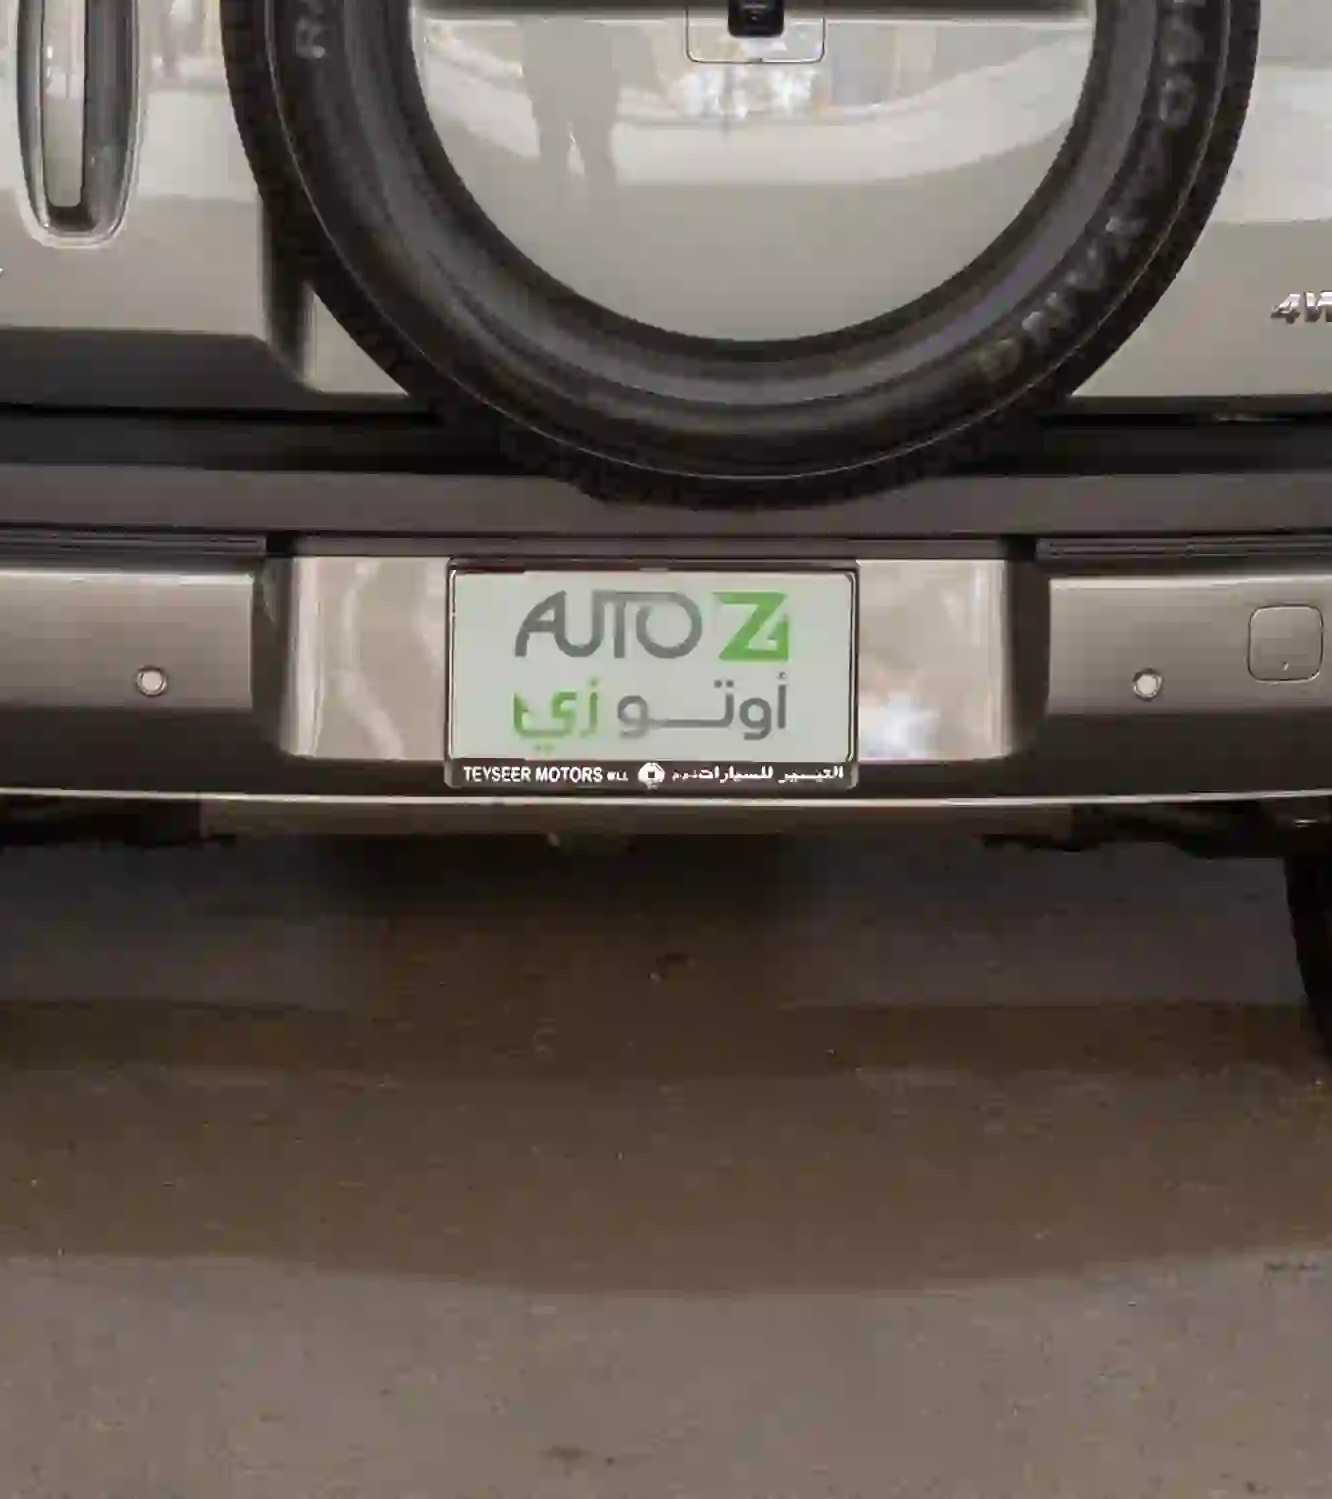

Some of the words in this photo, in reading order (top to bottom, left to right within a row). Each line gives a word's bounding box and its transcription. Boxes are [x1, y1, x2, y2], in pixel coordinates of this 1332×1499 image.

[513, 588, 703, 660] AUTO
[512, 676, 601, 754] زي
[463, 765, 532, 783] TEYSEER
[535, 766, 603, 784] MOTORS
